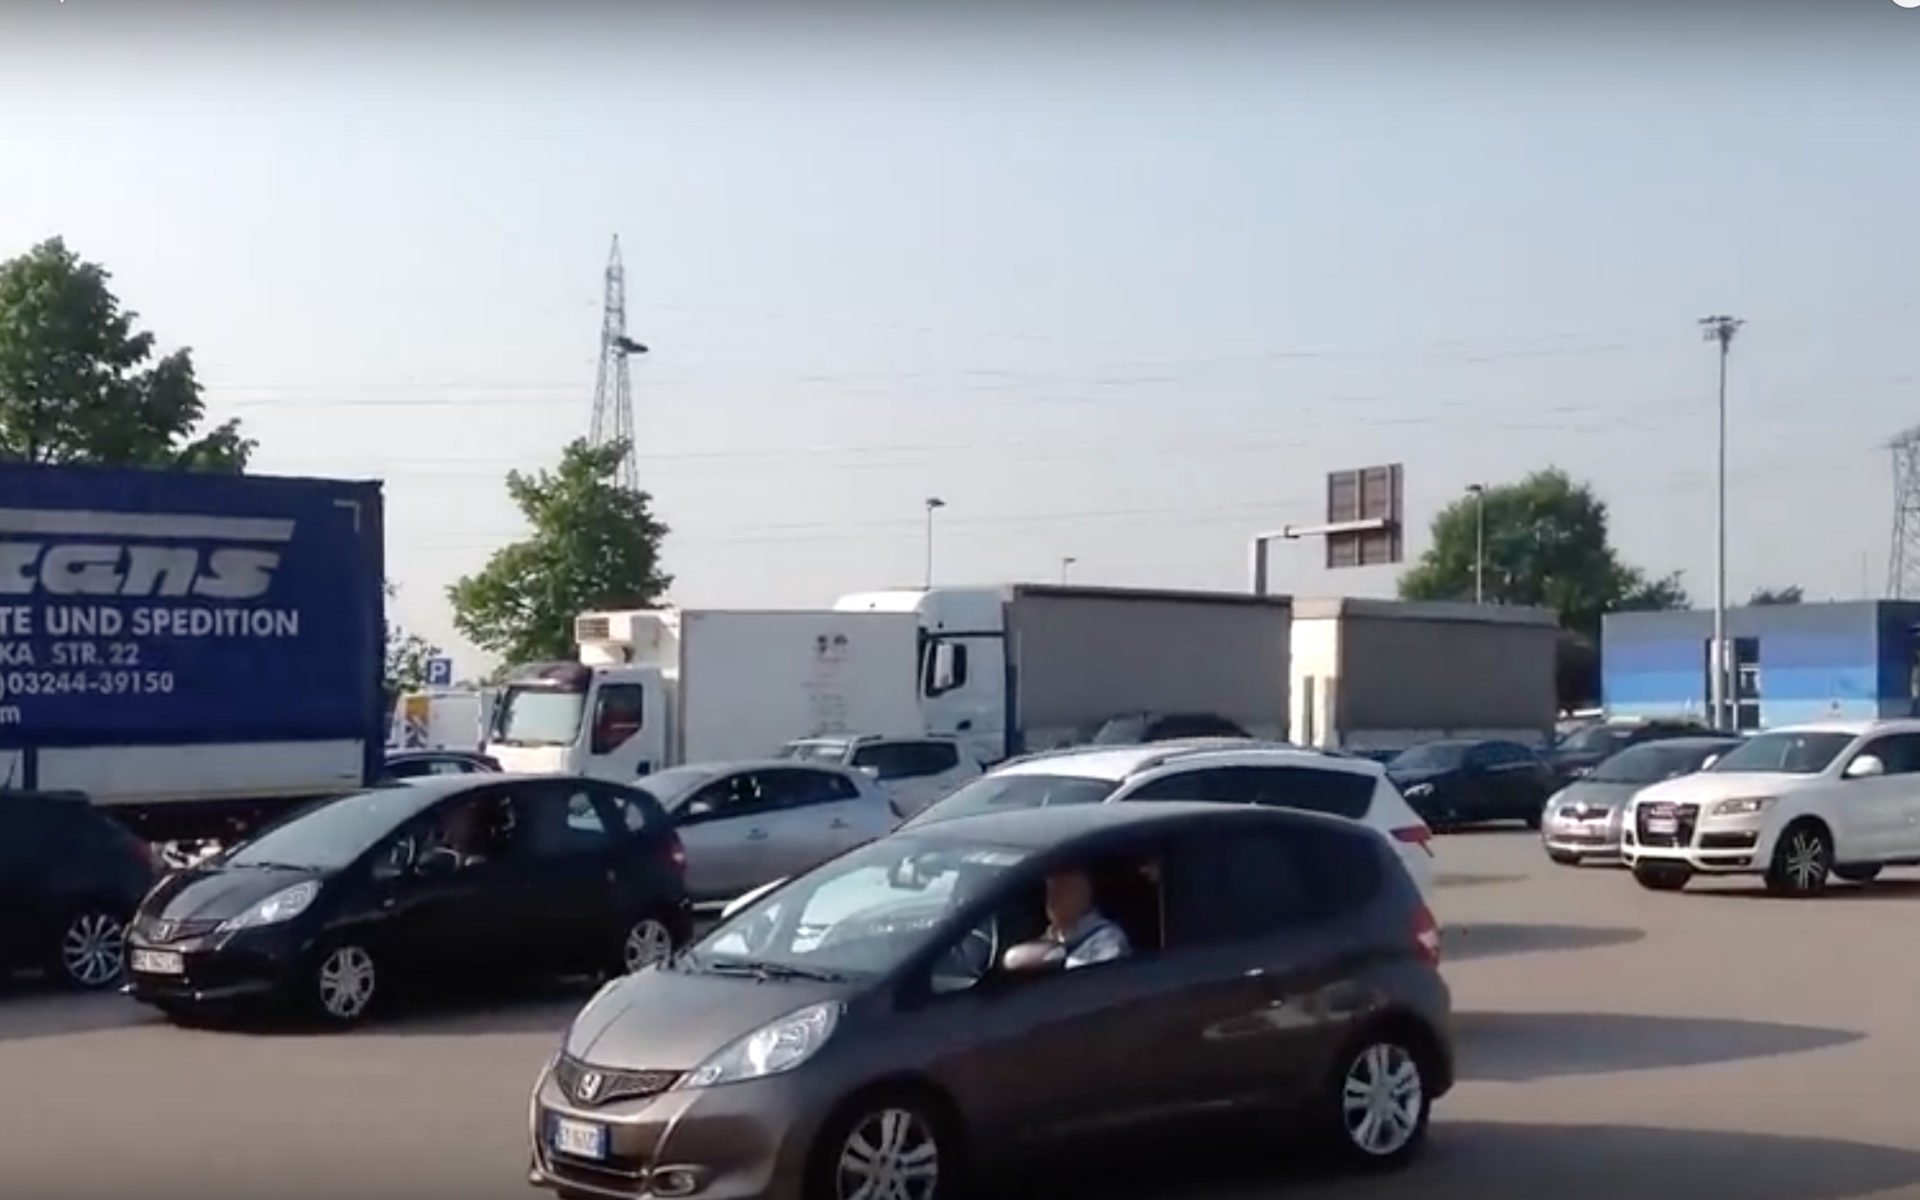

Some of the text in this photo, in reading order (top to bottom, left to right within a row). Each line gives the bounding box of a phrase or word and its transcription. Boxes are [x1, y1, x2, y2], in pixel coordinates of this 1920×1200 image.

[0, 606, 299, 636] TE UND SPEDITION
[0, 642, 140, 665] KA STR. 22
[430, 662, 447, 682] P
